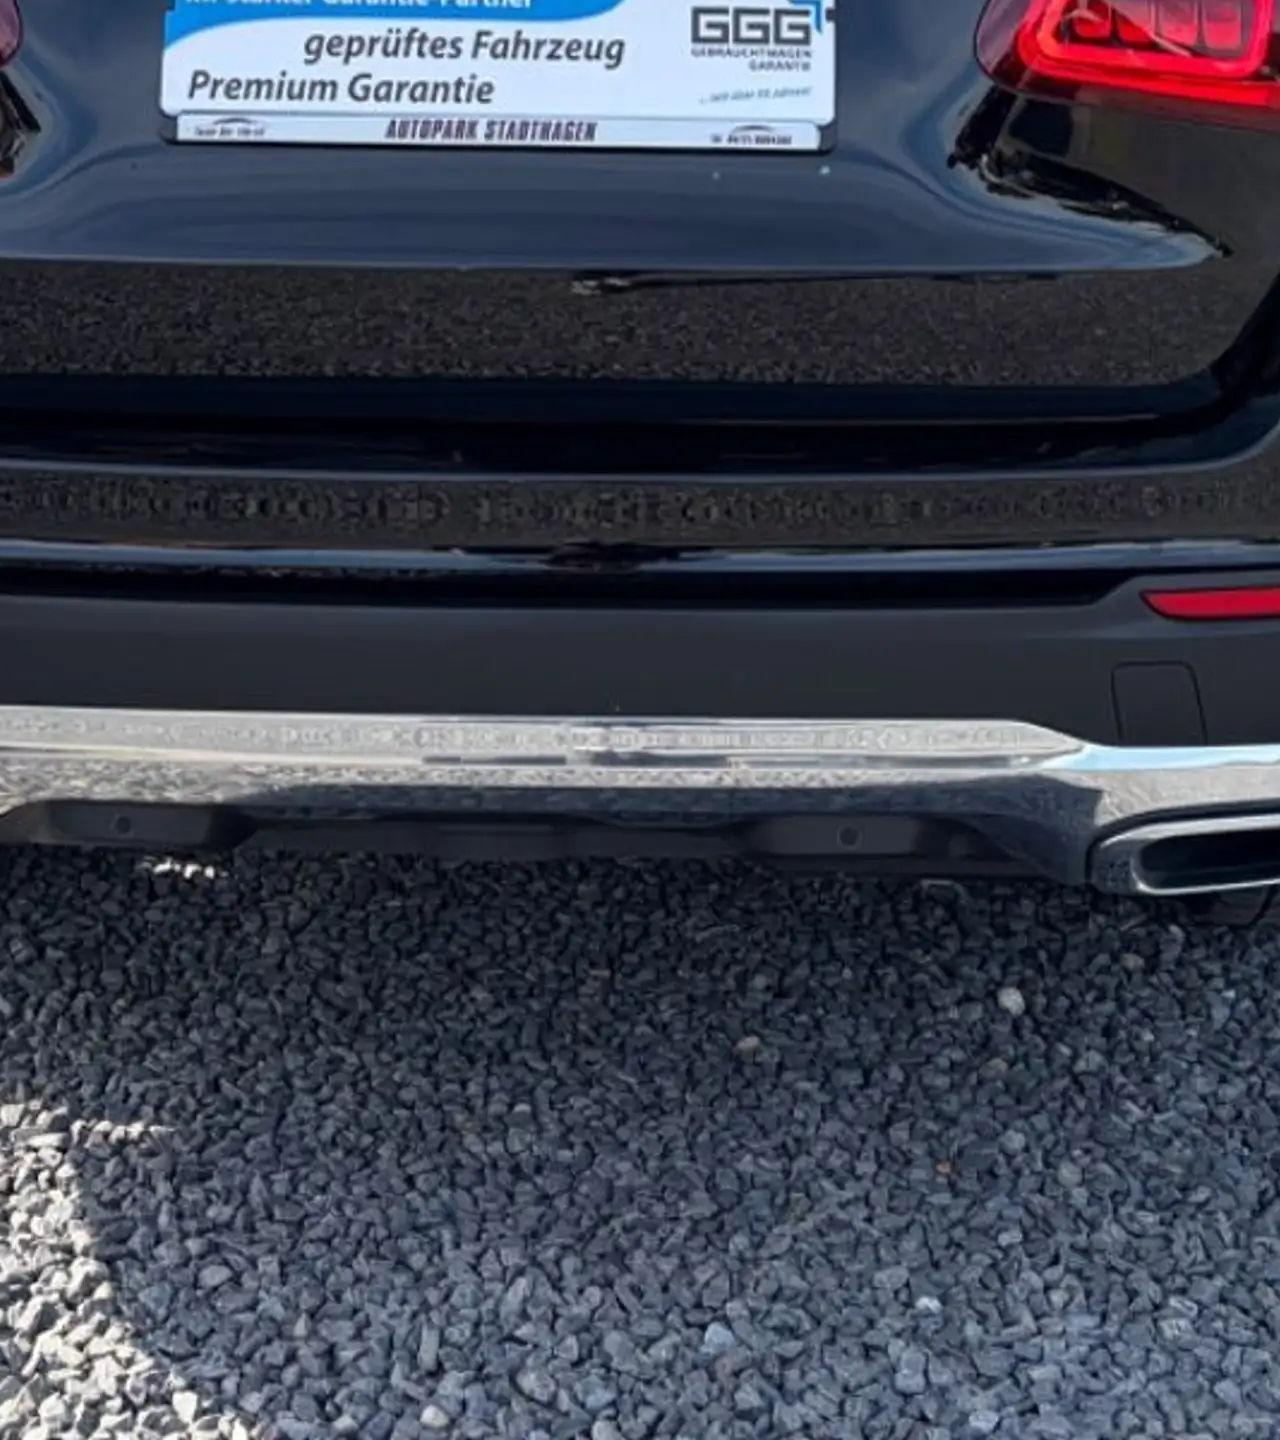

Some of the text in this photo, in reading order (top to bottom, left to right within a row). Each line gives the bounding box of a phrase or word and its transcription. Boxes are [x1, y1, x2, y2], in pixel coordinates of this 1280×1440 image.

[691, 6, 812, 46] GGG
[304, 27, 626, 70] geprüftes Fahrzeug
[187, 69, 495, 104] Premium Garantie
[384, 118, 599, 142] AUTOPARK STADTHAGEN
